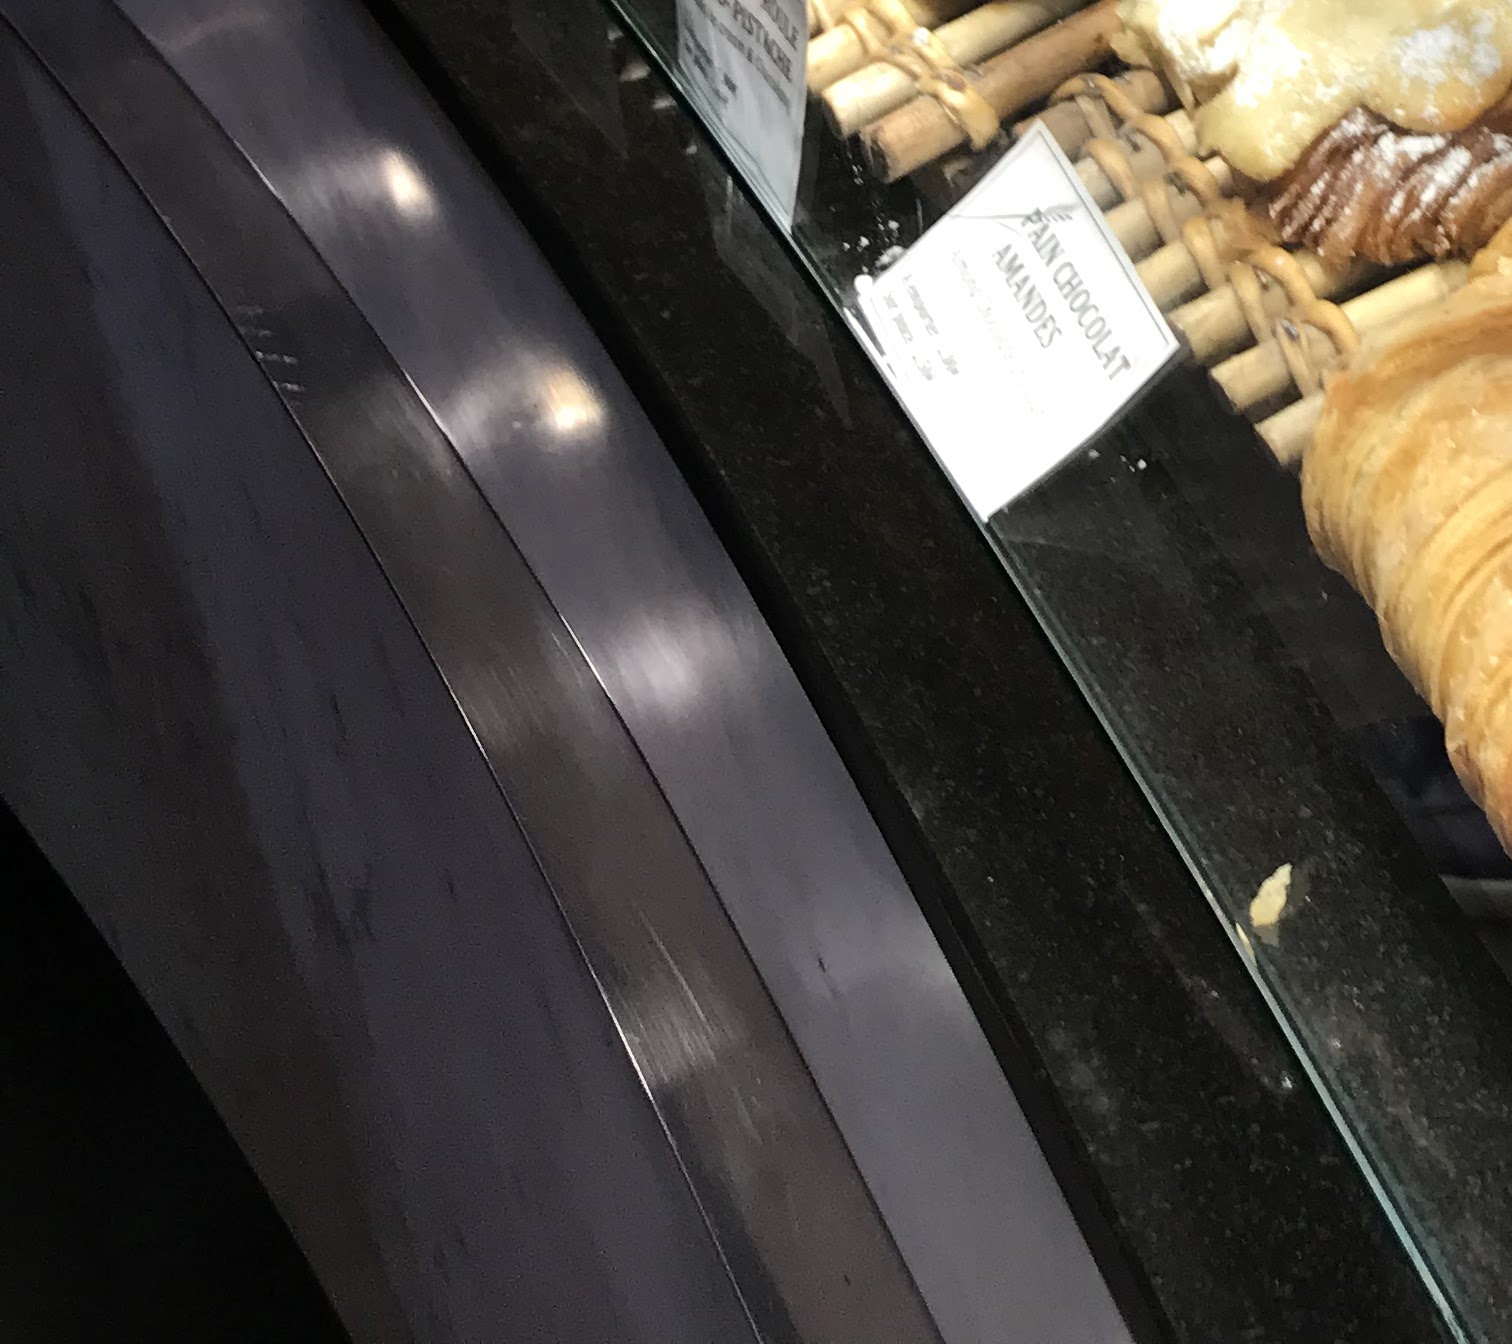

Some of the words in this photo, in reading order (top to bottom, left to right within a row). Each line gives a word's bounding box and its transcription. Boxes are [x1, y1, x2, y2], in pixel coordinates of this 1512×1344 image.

[991, 243, 1063, 349] AMANDES
[1020, 207, 1066, 268] PAIN
[1052, 260, 1132, 381] CHOCOLAT
